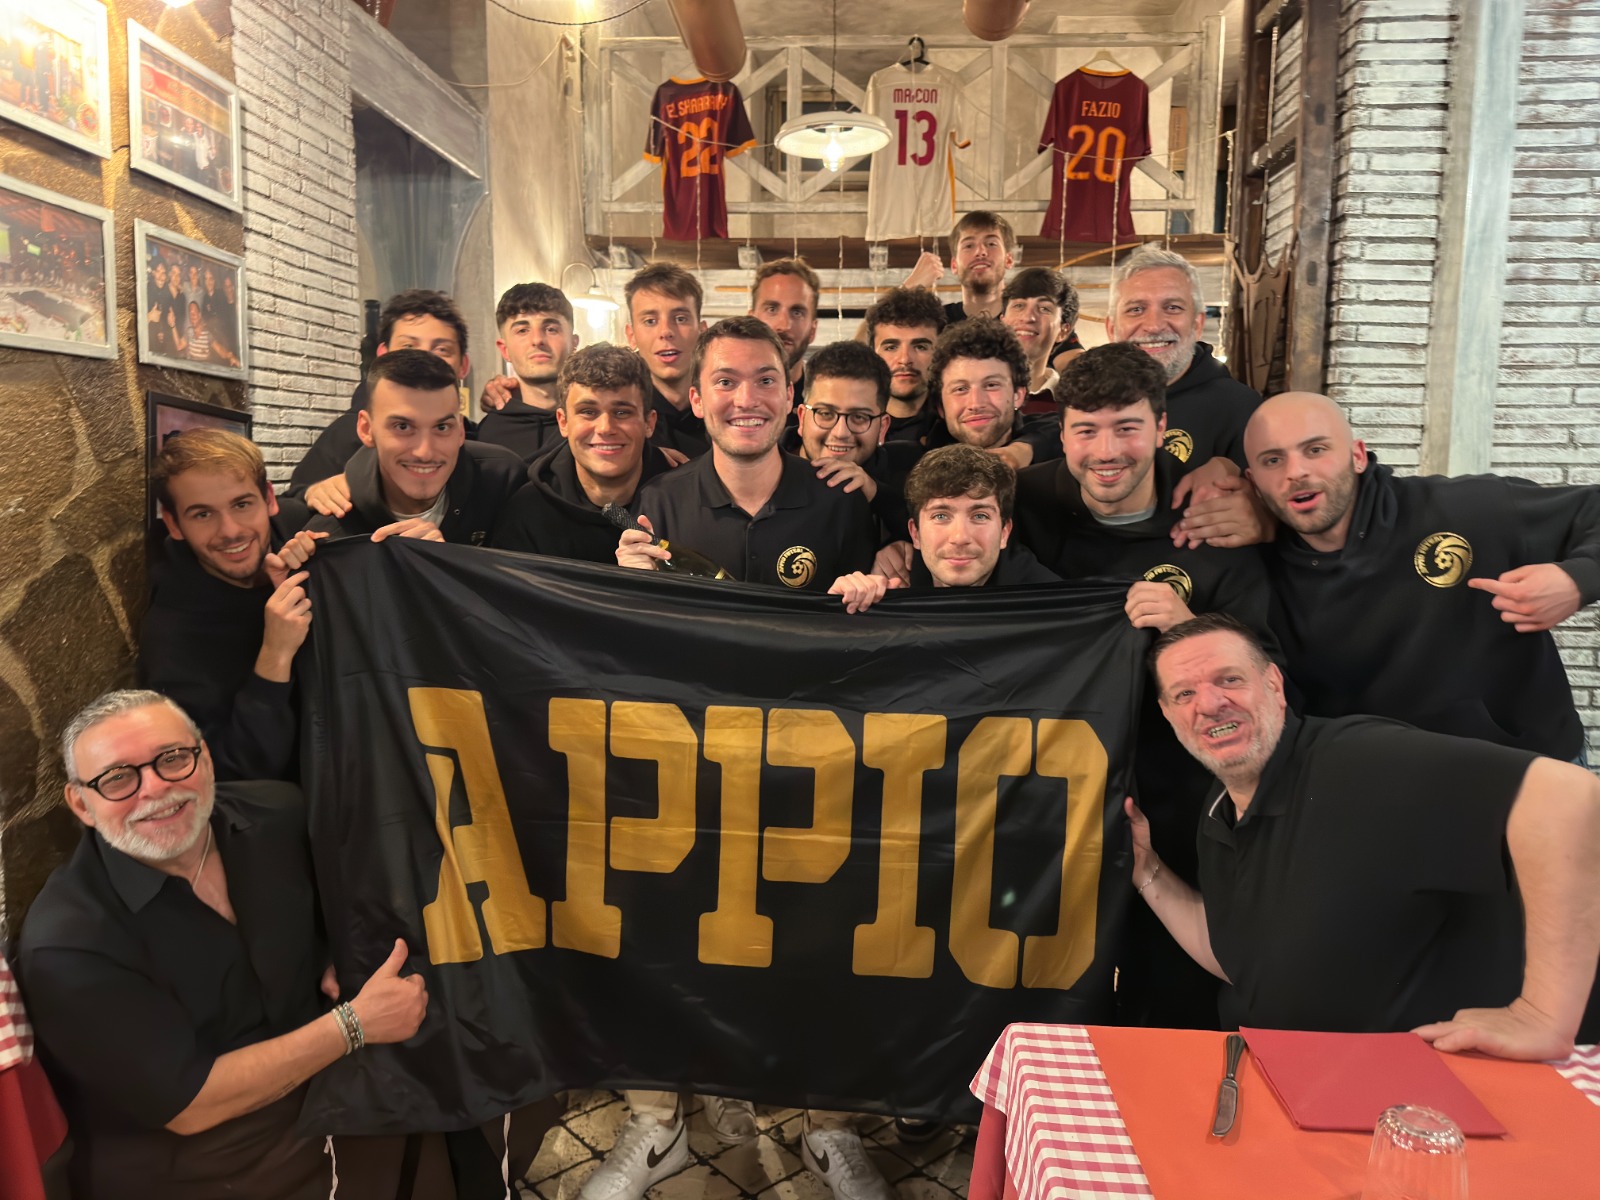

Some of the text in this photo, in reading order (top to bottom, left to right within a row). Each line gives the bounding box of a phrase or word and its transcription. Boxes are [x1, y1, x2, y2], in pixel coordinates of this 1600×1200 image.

[893, 88, 938, 104] MACON
[1081, 100, 1122, 118] FAZIO
[677, 117, 719, 178] 22
[894, 110, 938, 167] 13
[1067, 124, 1127, 183] 20
[407, 686, 1109, 992] APPIO
